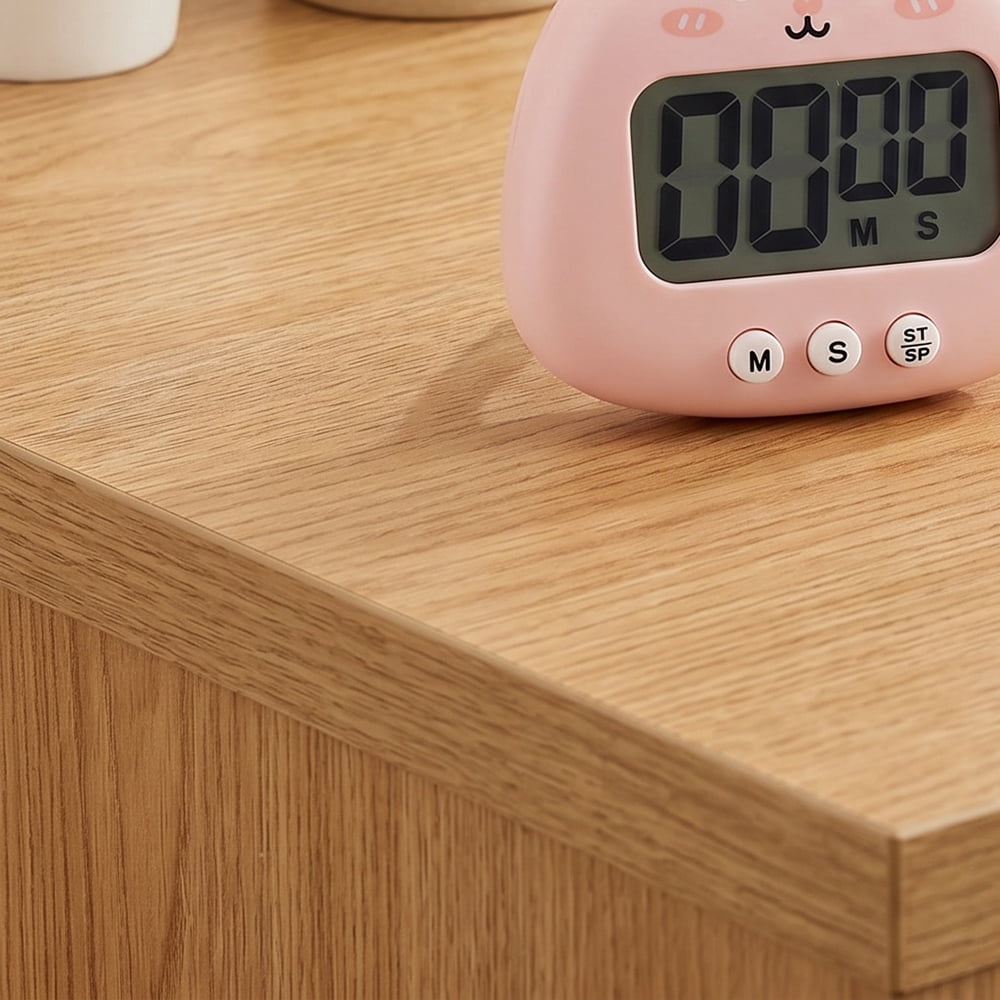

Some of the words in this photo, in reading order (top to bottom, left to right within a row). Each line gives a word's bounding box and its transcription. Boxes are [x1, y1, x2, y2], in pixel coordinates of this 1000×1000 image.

[849, 217, 879, 248] M
[917, 211, 940, 241] S
[903, 326, 929, 343] ST
[749, 348, 771, 373] M
[828, 340, 848, 364] S
[904, 346, 930, 363] SP
